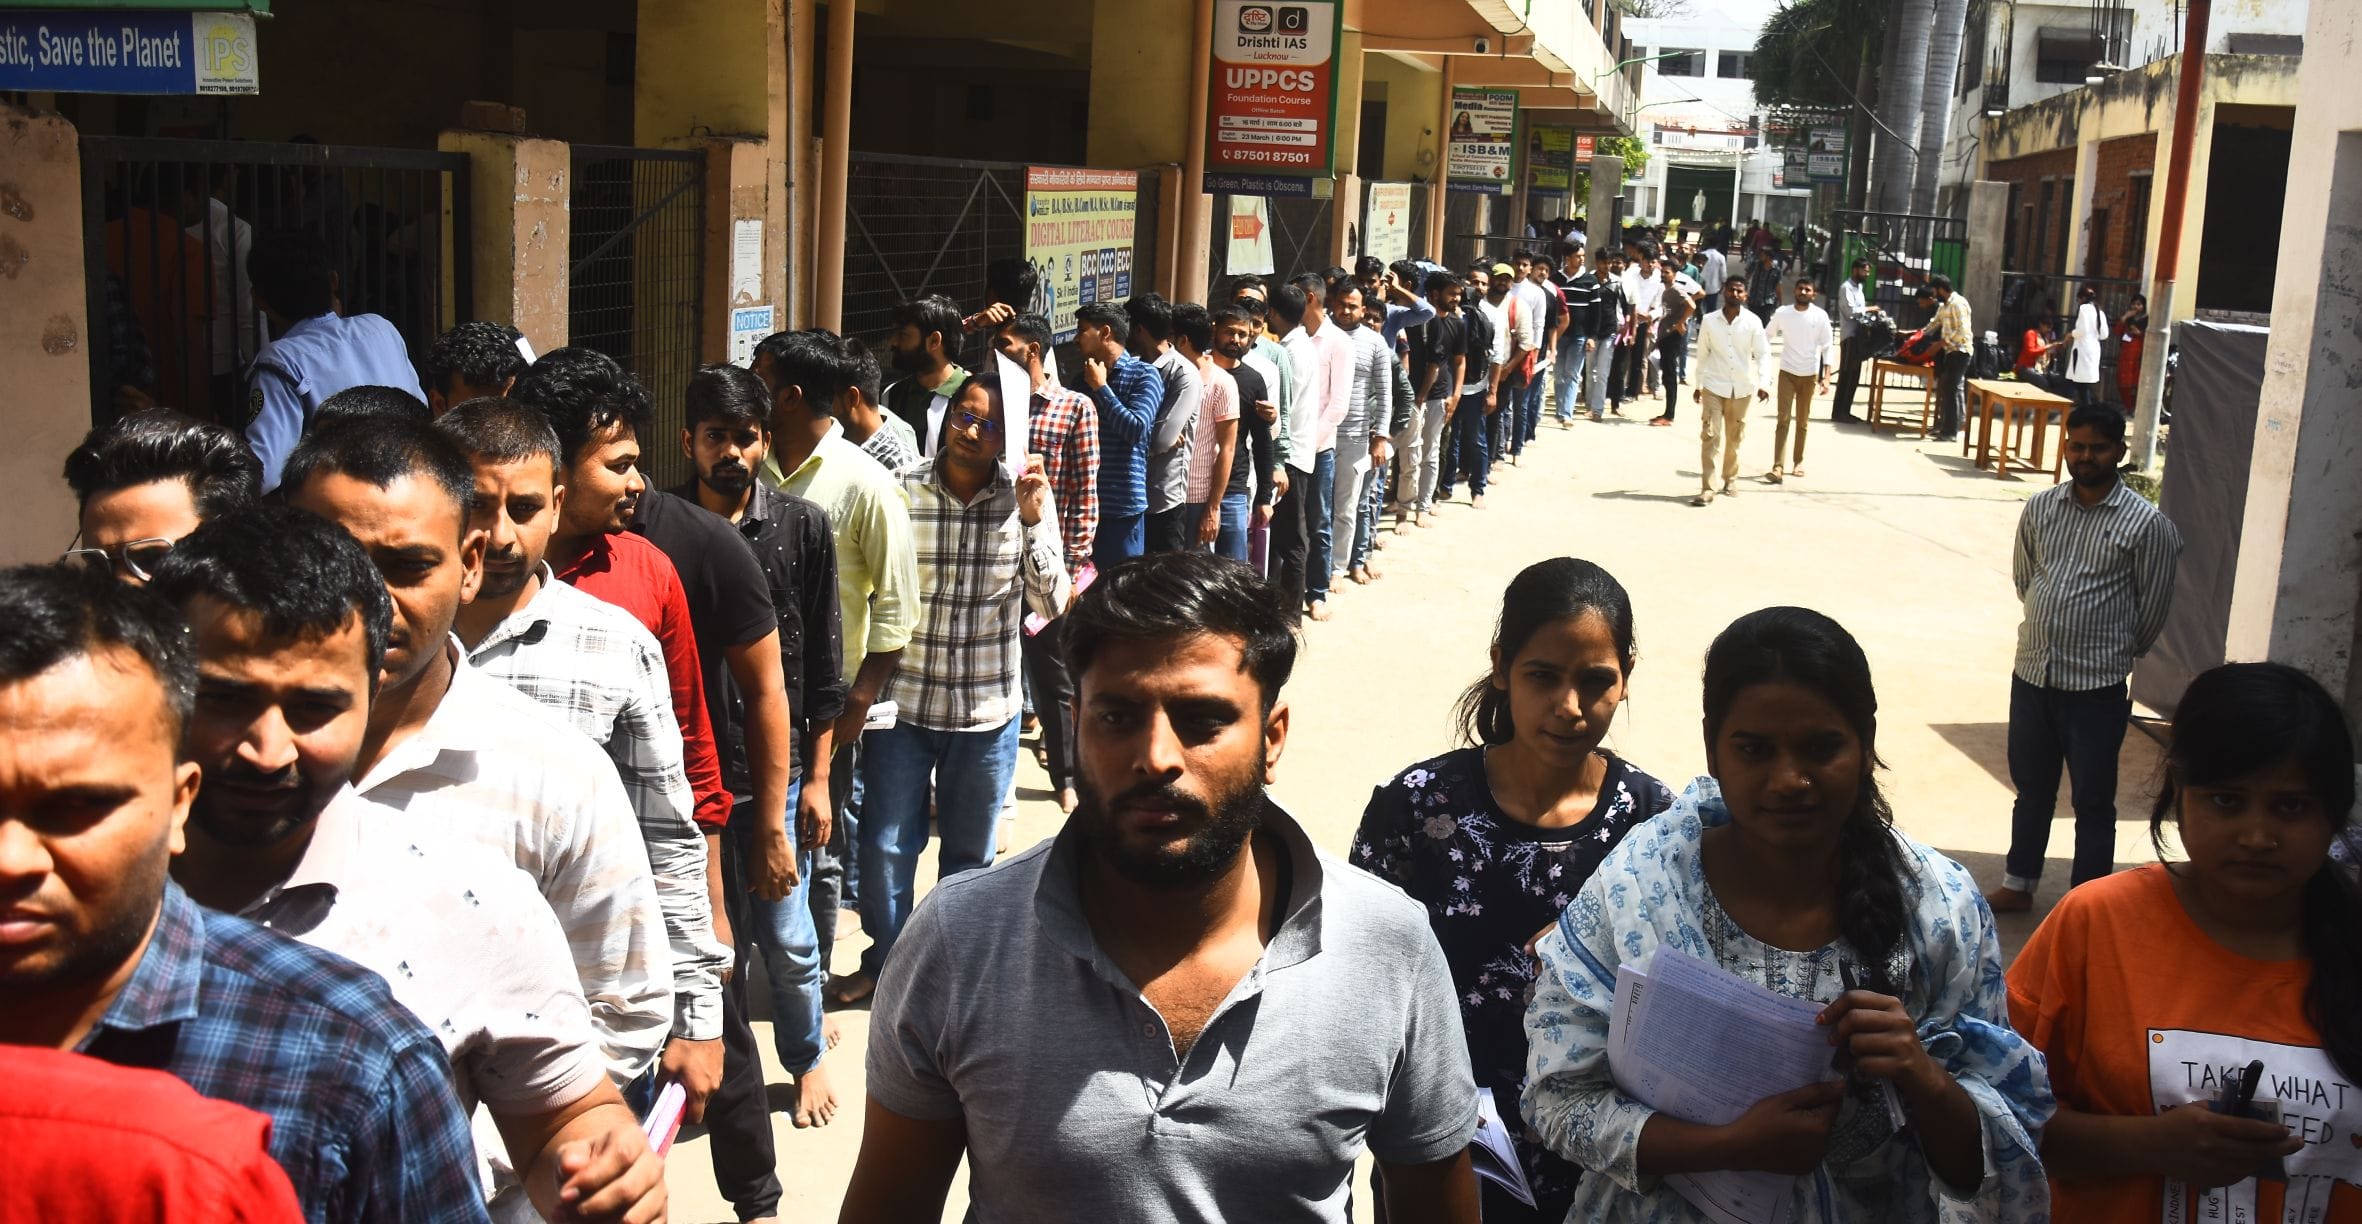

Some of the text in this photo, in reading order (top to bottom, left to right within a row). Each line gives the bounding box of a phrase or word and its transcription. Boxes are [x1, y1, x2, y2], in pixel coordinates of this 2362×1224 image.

[38, 26, 83, 66] Save
[88, 27, 117, 66] the
[121, 27, 182, 68] Planet
[1237, 36, 1307, 49] Drishti IAS
[203, 37, 250, 72] IPS
[1253, 51, 1289, 61] Lucknow
[1226, 68, 1315, 92] UPPCS
[1227, 93, 1312, 105] Foundation Course
[1454, 101, 1483, 111] Media
[1234, 150, 1310, 163] 87501 87501
[1462, 144, 1510, 156] ISB&M
[1206, 177, 1216, 188] Go
[1241, 178, 1264, 190] Plastic
[1266, 181, 1272, 190] is
[1031, 217, 1133, 247] DIGITAL LITERACY COURSE
[1081, 254, 1097, 277] BCC
[1100, 251, 1114, 274] CCC
[1117, 250, 1130, 272] ECC
[1056, 286, 1066, 299] Skll
[736, 311, 769, 330] NOTICE
[2271, 1074, 2351, 1110] WHAT
[2283, 1113, 2334, 1145] EED
[2167, 1182, 2181, 1224] KINDNE
[2208, 1196, 2220, 1220] HUG
